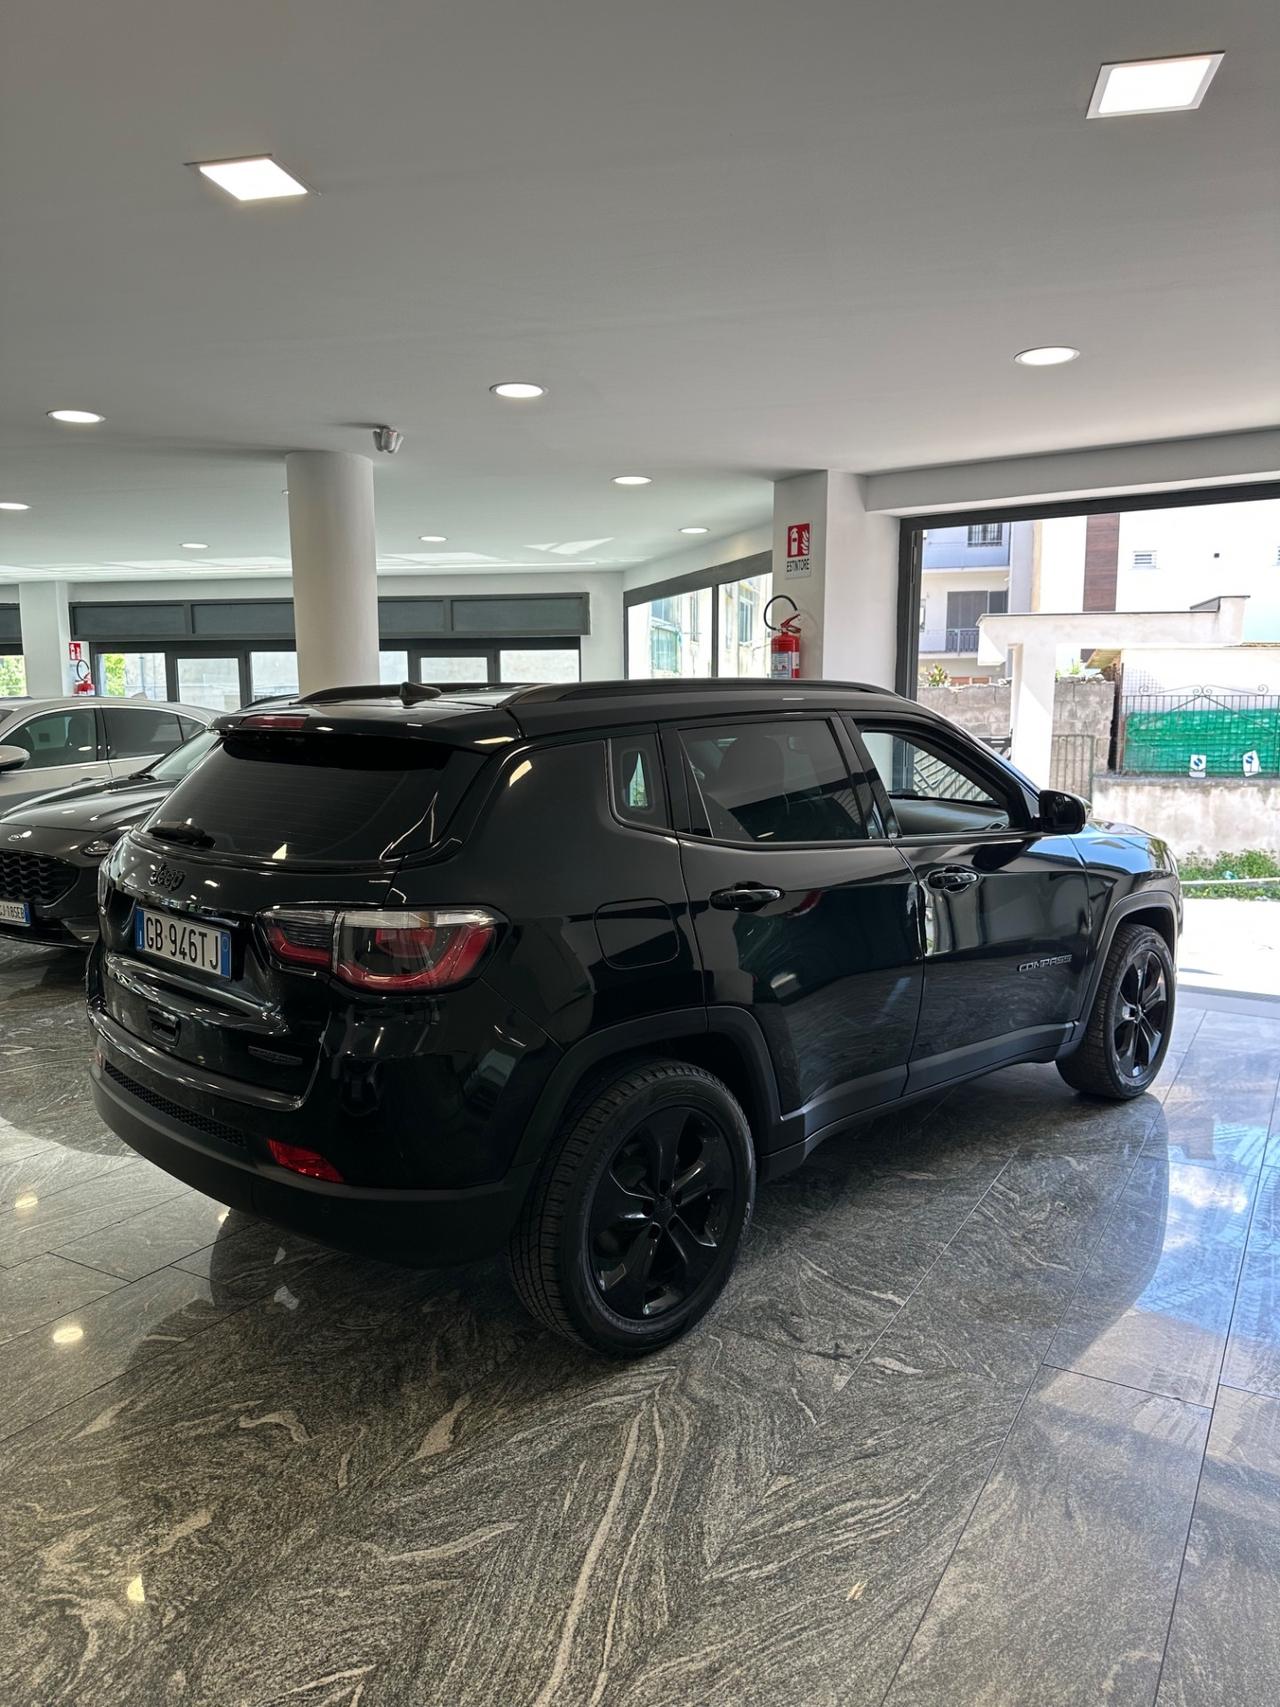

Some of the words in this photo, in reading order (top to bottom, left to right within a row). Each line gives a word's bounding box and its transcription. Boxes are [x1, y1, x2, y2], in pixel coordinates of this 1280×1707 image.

[786, 558, 810, 572] ESTINTORE
[148, 863, 185, 891] Jeep
[146, 917, 163, 951] GB
[169, 923, 220, 970] 946TJ
[1018, 954, 1072, 972] COMPASS
